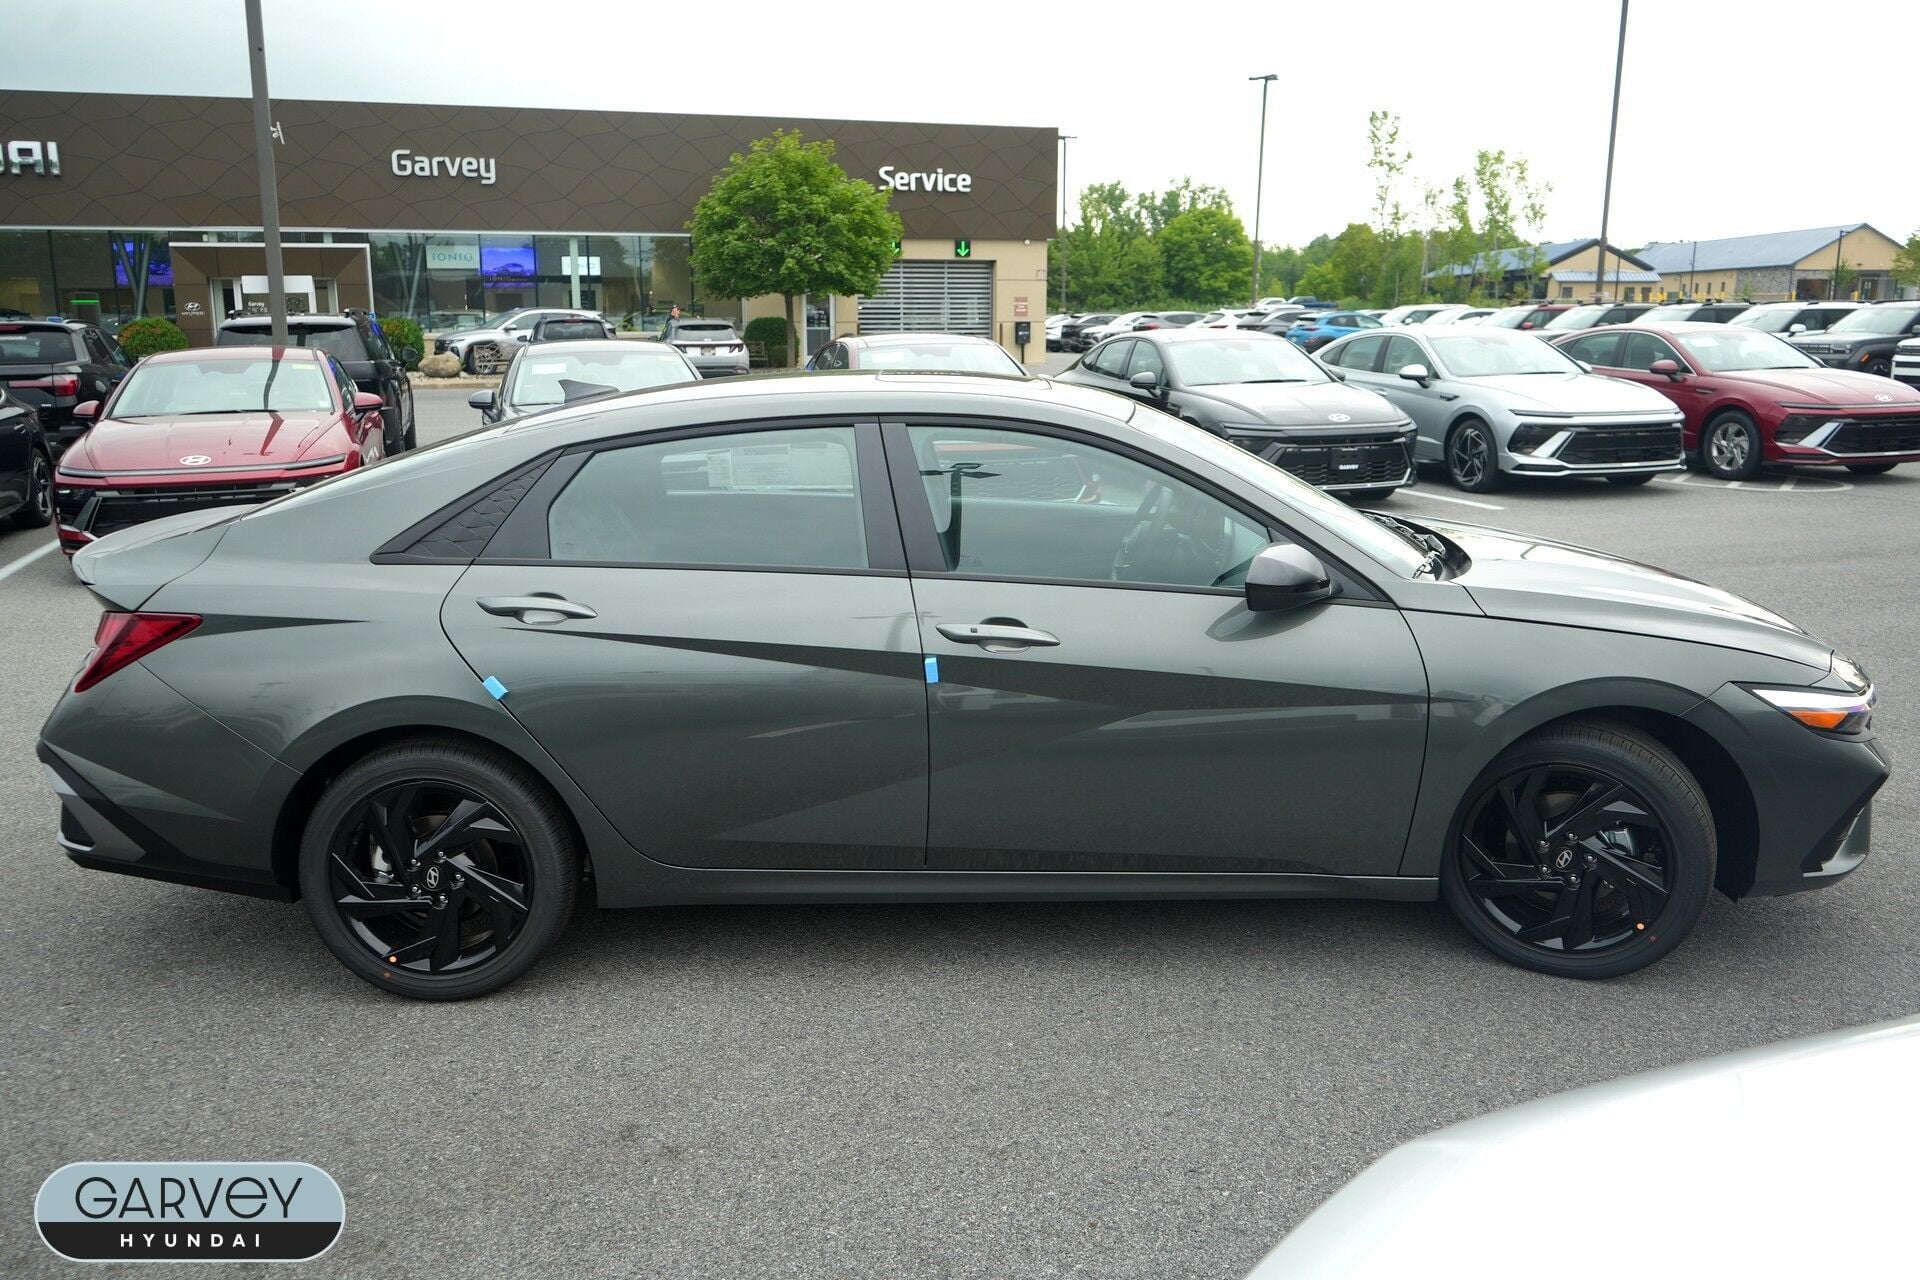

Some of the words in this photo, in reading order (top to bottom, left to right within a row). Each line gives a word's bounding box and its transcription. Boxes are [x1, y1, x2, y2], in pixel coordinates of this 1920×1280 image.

[0, 140, 61, 176] AI
[391, 149, 496, 185] Garvey
[878, 166, 972, 192] Service
